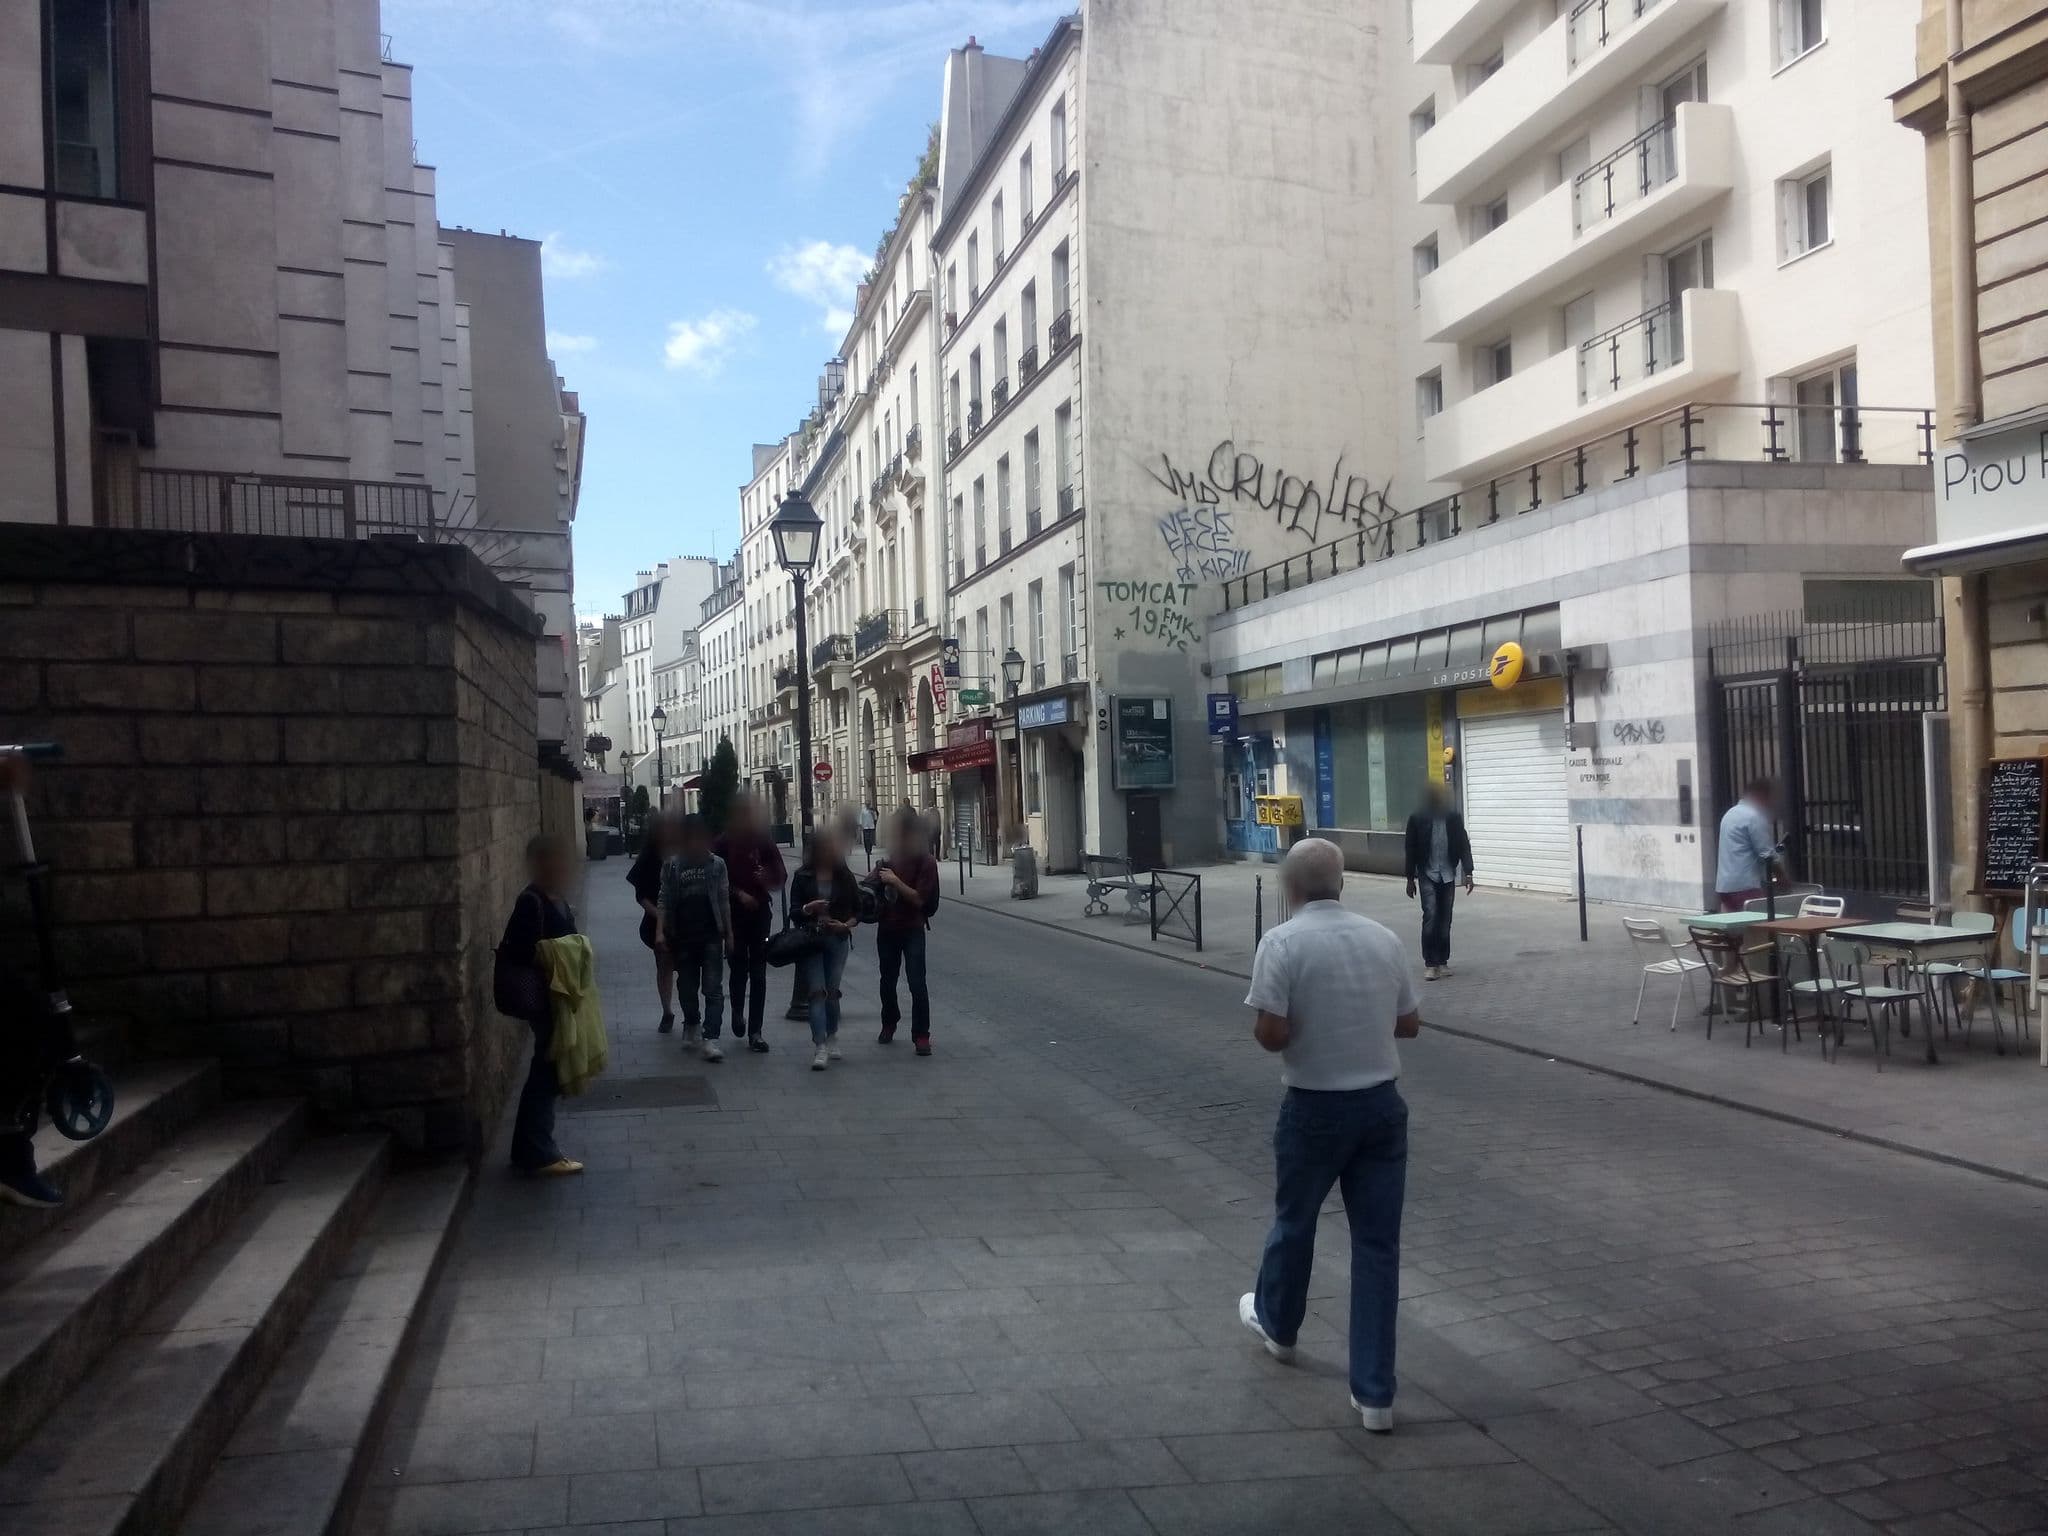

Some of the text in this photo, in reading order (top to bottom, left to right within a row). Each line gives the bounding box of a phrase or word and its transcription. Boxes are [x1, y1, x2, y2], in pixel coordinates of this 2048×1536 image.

[1944, 453, 2026, 501] Piou
[1097, 581, 1198, 606] TOMCAT
[1129, 606, 1158, 635] 19
[933, 664, 946, 711] TABAC
[1433, 668, 1491, 685] LA POSTE
[1019, 704, 1045, 725] PARKING
